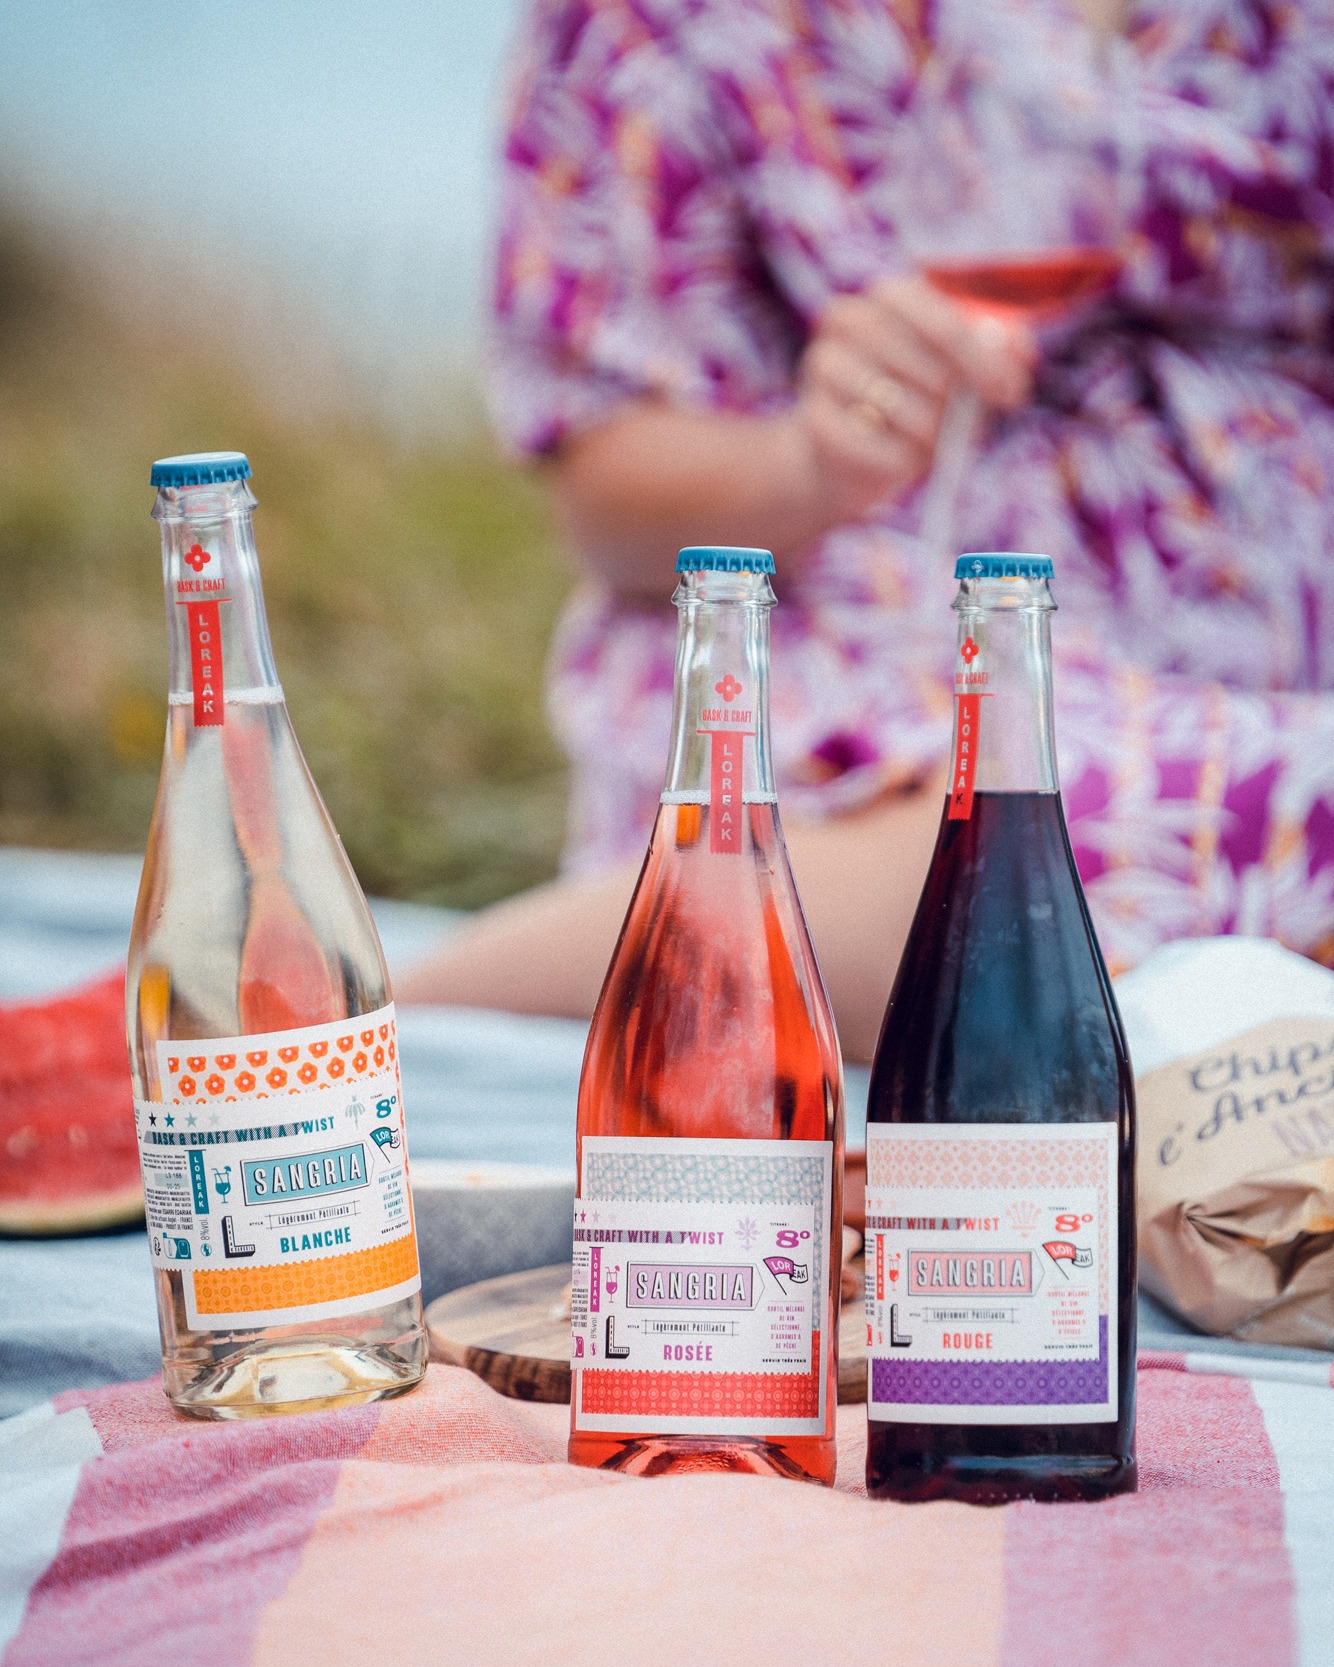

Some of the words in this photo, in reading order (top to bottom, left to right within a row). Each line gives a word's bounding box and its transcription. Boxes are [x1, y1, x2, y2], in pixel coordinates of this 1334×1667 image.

[178, 580, 192, 593] BASK
[202, 578, 226, 592] CRAFT
[198, 614, 214, 713] LOREAK
[702, 710, 722, 722] BASK
[732, 710, 752, 724] CRAFT
[955, 706, 970, 805] LOREAK
[721, 744, 733, 840] LOREAK
[152, 1131, 175, 1146] BASK
[190, 1130, 229, 1146] CRAFT
[235, 1126, 272, 1142] WITH
[278, 1124, 287, 1138] A
[294, 1116, 335, 1136] TWIST
[194, 1156, 204, 1208] LOREAK
[254, 1152, 362, 1196] SANGRIA
[594, 1229, 624, 1242] CRAFT
[628, 1230, 660, 1243] WITH
[665, 1231, 674, 1244] A
[680, 1231, 725, 1244] TWIST
[878, 1216, 902, 1230] CRAFT
[906, 1217, 936, 1230] WITH
[942, 1217, 950, 1230] A
[956, 1217, 1000, 1231] TWIST
[280, 1226, 352, 1254] BLANCHE
[771, 1260, 790, 1271] LOR
[916, 1258, 1025, 1288] SANGRIA
[636, 1271, 746, 1300] SANGRIA
[663, 1340, 713, 1362] ROSÉE
[942, 1332, 994, 1349] ROUGE
